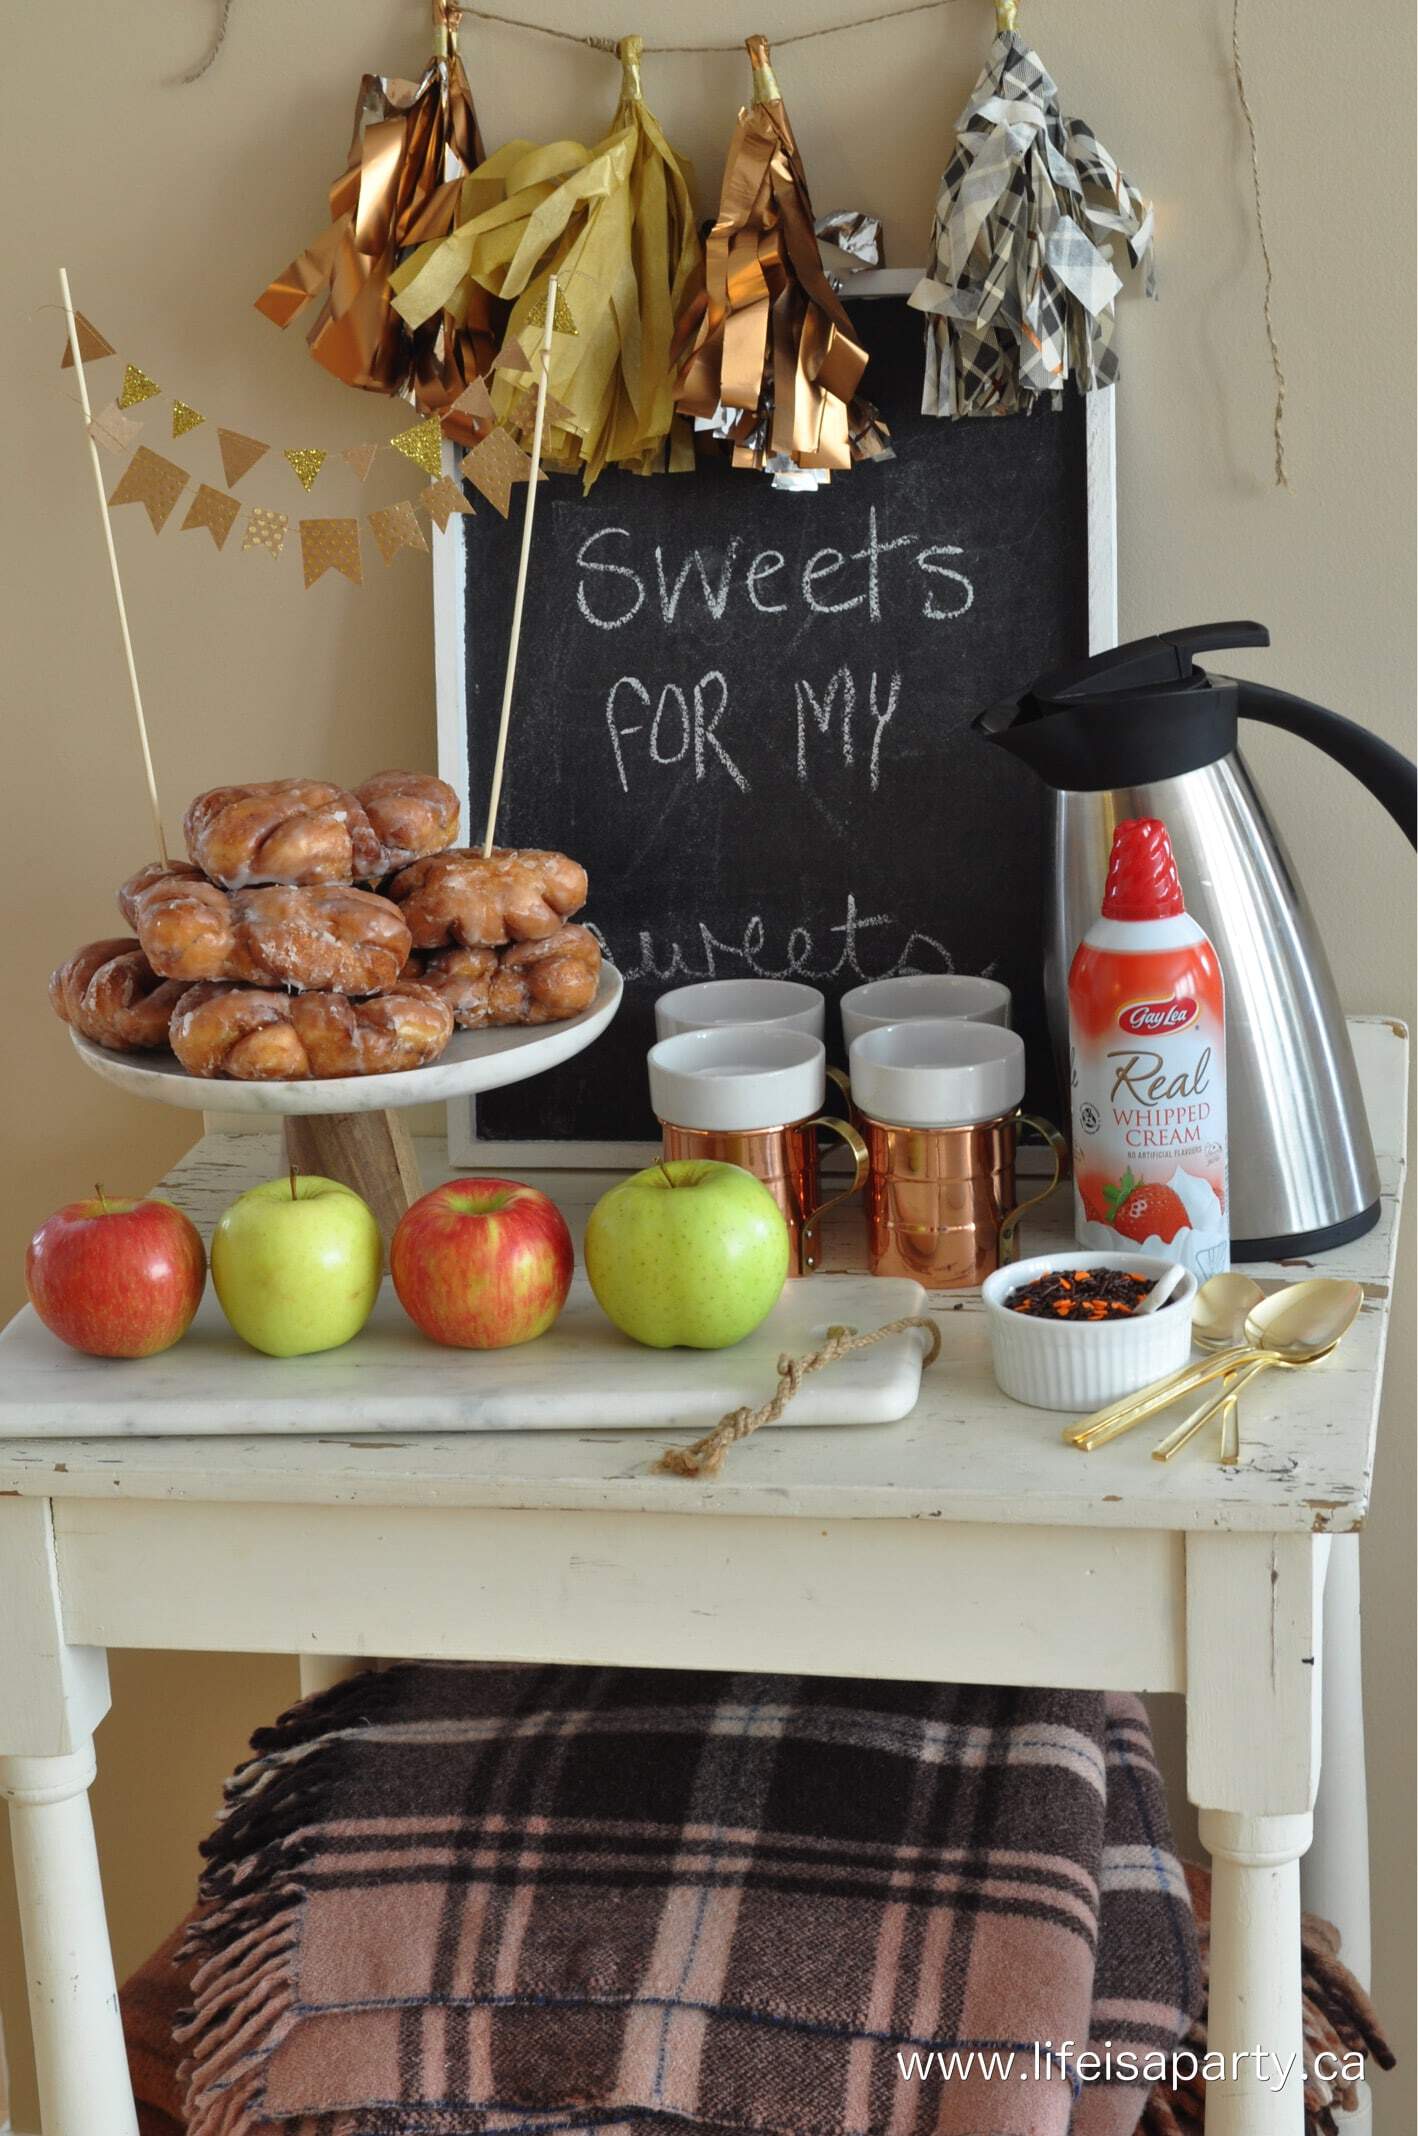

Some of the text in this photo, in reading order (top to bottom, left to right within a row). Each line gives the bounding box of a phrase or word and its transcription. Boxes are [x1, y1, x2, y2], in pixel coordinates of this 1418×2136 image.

[576, 505, 974, 629] Sweets
[607, 662, 901, 793] FOR MY
[1130, 1004, 1187, 1029] Gay Lea
[1107, 1047, 1211, 1106] Real
[1112, 1102, 1210, 1128] WHIPPED
[1125, 1127, 1201, 1147] CREAM
[1137, 1150, 1172, 1160] ARTIFICIAL
